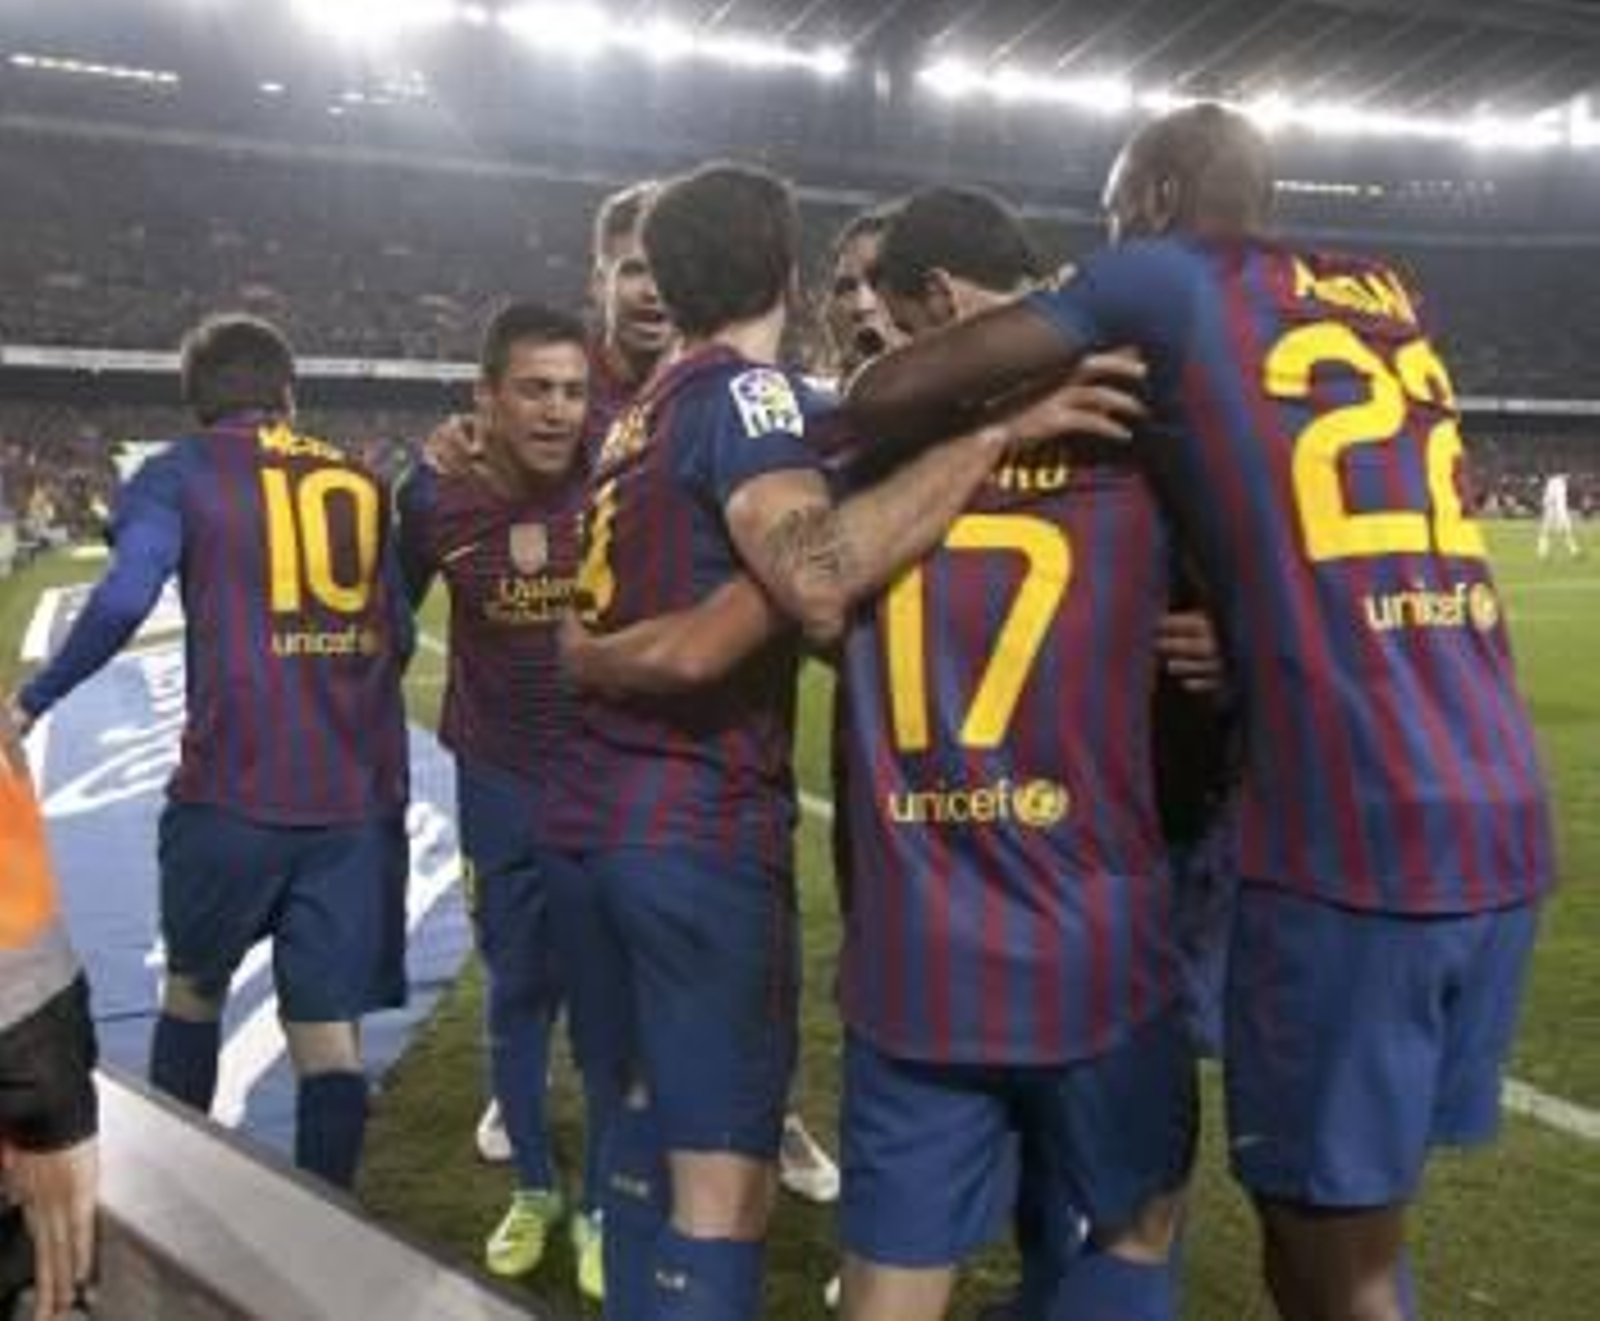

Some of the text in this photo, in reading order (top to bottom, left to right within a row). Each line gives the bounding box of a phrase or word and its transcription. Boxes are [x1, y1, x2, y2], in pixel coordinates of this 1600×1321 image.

[1264, 321, 1484, 561] 22
[262, 467, 378, 612] 10
[1365, 582, 1467, 630] unicef
[888, 514, 1071, 751] 17
[889, 778, 1011, 822] unicef
